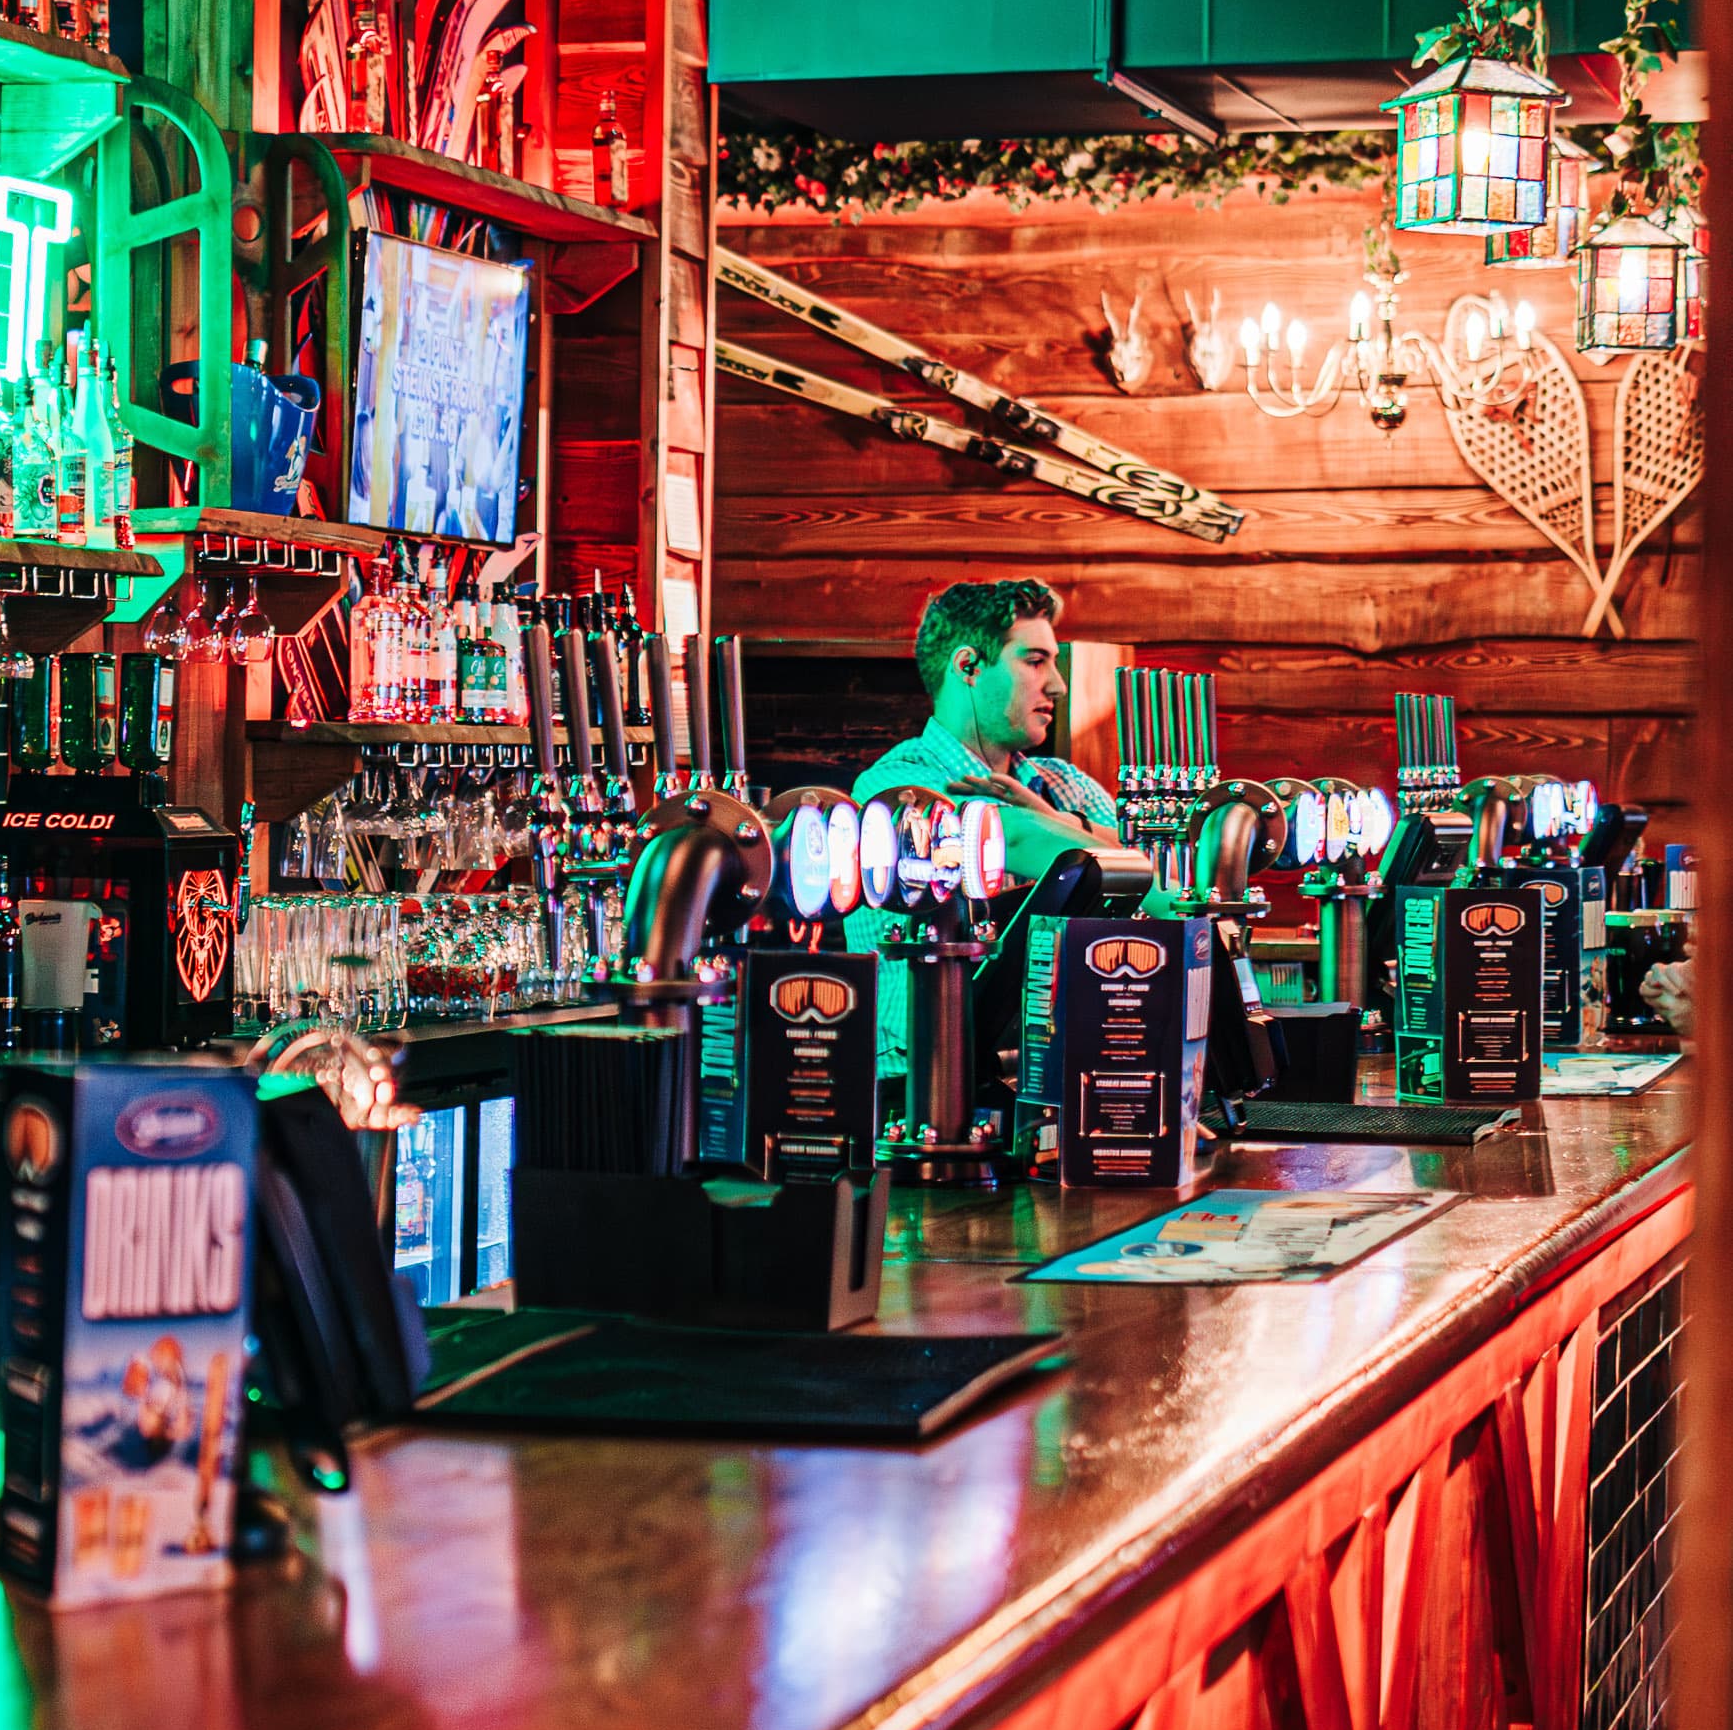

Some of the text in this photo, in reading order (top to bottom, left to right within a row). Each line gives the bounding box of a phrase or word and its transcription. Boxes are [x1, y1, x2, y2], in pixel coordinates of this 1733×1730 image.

[1, 812, 116, 830] ICE COLD!
[1404, 897, 1434, 976] TOWERS
[81, 1162, 245, 1321] DRINKS
